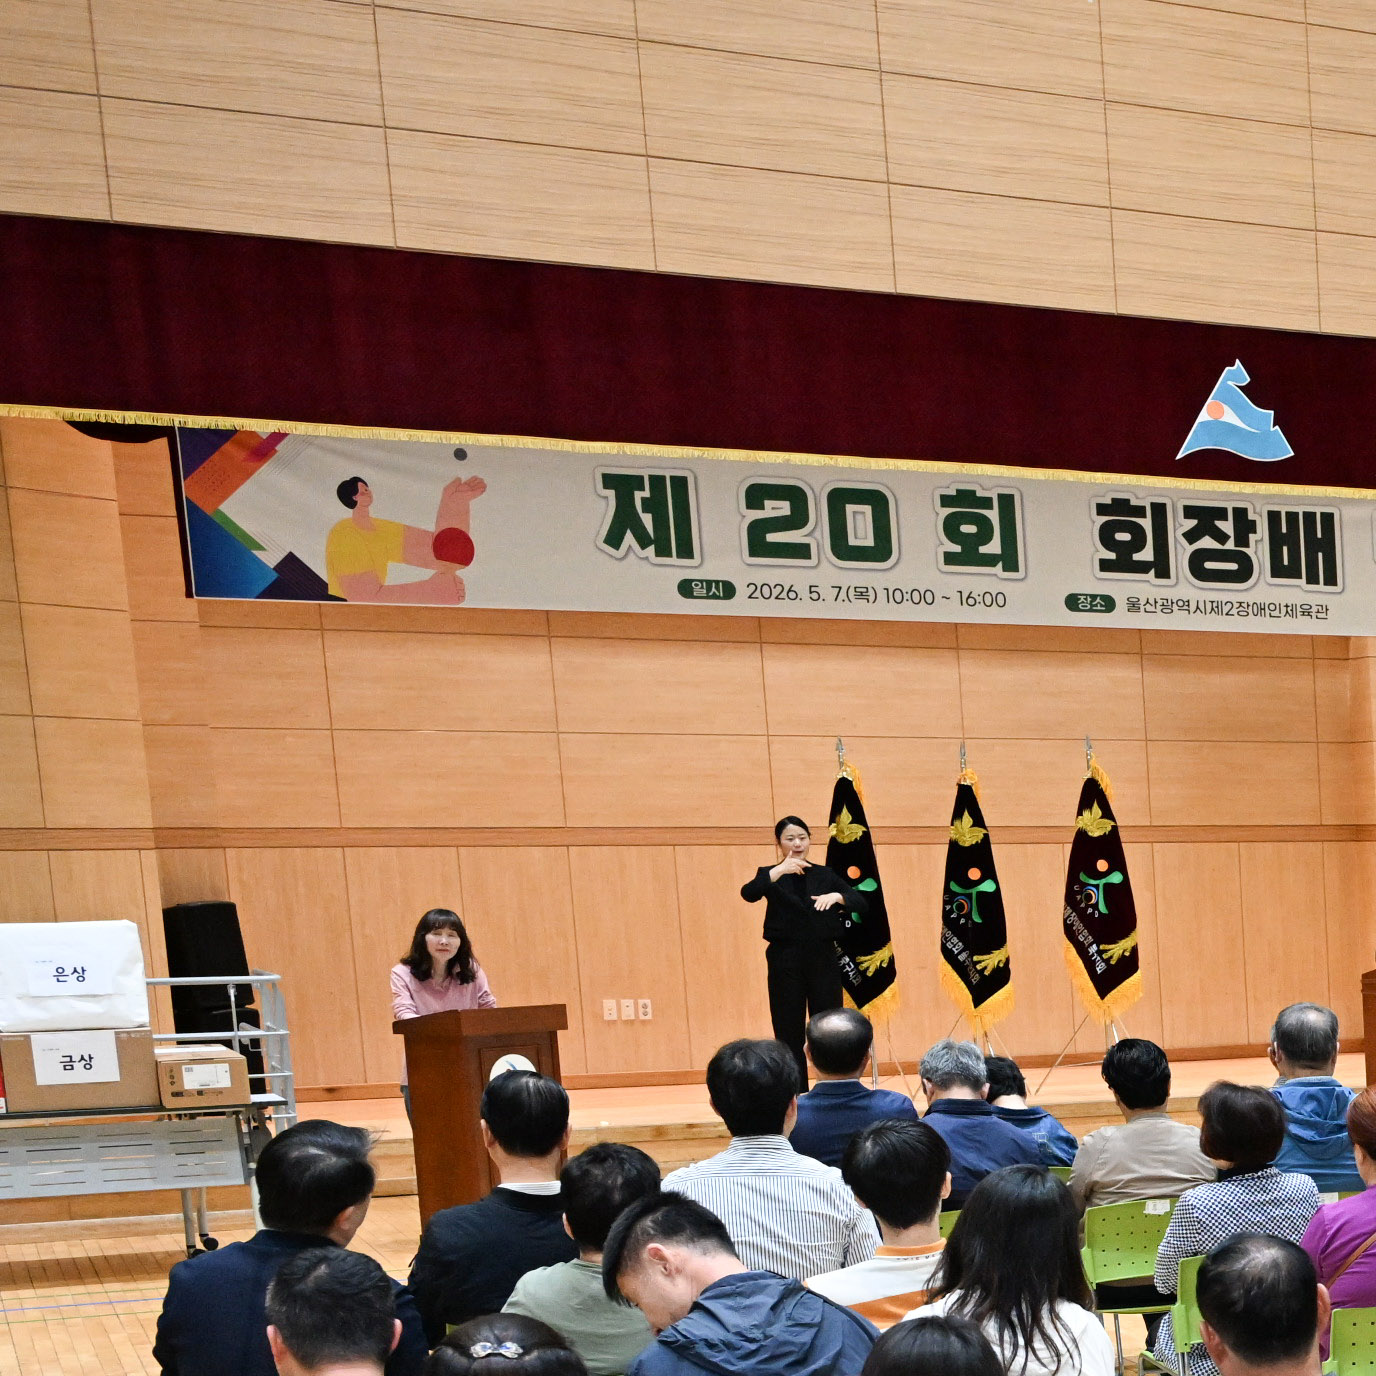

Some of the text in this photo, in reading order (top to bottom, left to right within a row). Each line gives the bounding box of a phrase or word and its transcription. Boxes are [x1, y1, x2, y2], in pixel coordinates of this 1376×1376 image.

[601, 472, 698, 562] 제
[744, 482, 894, 565] 20
[937, 486, 1023, 575] 회
[1094, 495, 1340, 588] 회장배
[691, 581, 724, 598] 일시
[746, 582, 803, 601] 2026.
[808, 585, 826, 602] 5.
[831, 586, 877, 604] 7.(목)
[883, 588, 936, 606] 10:00
[957, 590, 1007, 608] 16:00
[1077, 594, 1329, 620] 장소 울산광역시제2장애인체육관
[53, 966, 87, 983] 은상
[59, 1054, 94, 1071] 금상
